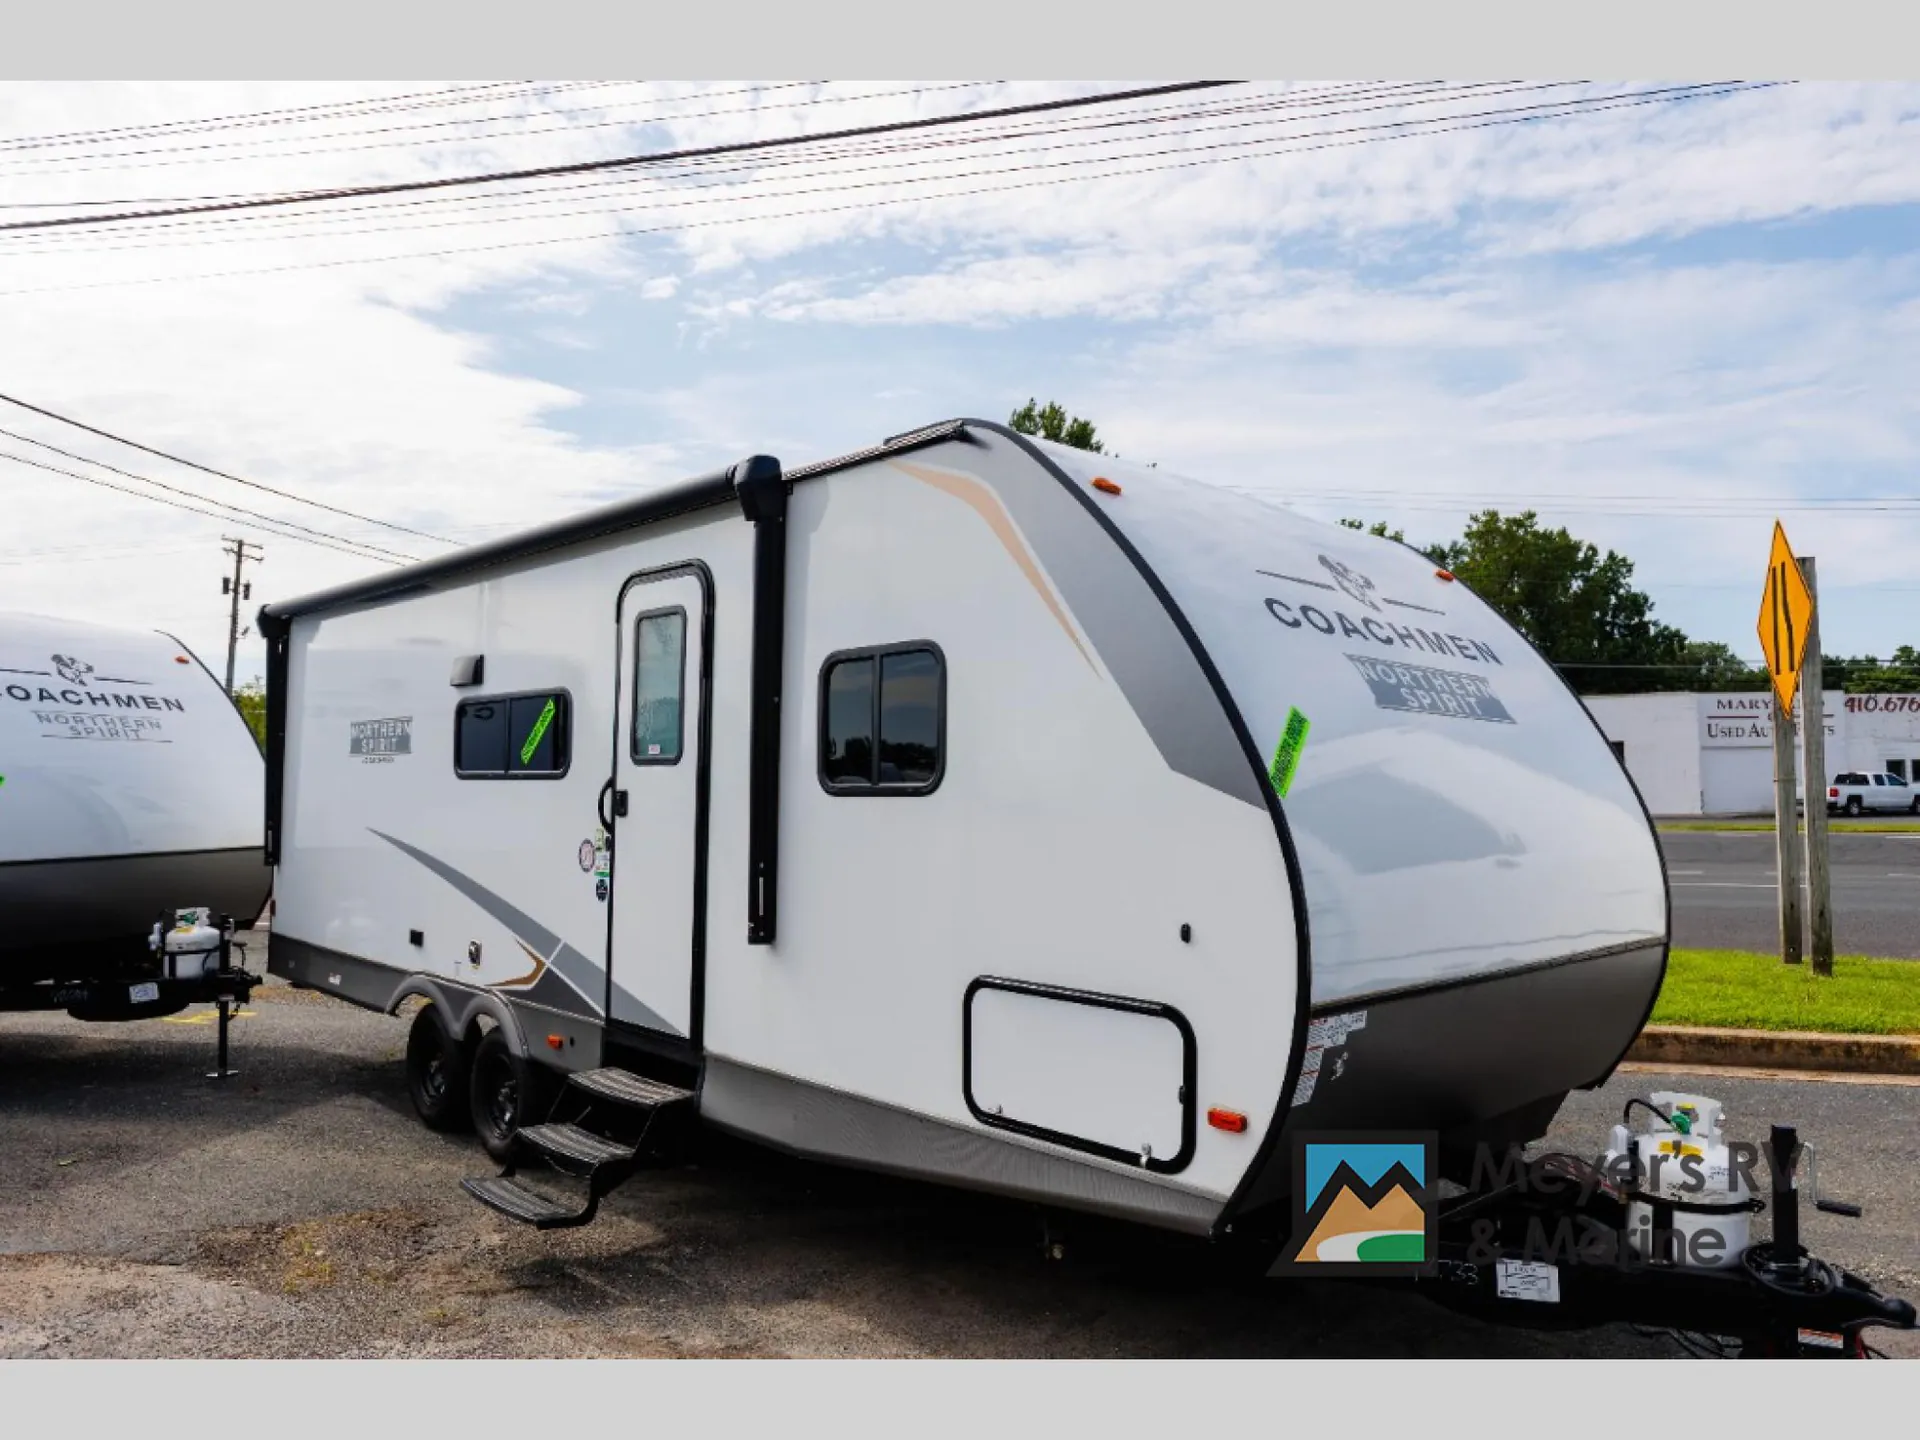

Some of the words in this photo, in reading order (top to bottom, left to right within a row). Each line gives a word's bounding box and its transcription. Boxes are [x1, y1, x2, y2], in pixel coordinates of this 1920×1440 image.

[1264, 597, 1503, 665] COACHMEN
[1353, 658, 1495, 698] NORTHERN
[0, 684, 185, 712] OACHMEN
[1400, 687, 1483, 716] SPIRIT
[36, 712, 163, 731] NORTHERN
[69, 725, 141, 740] SPIRIT
